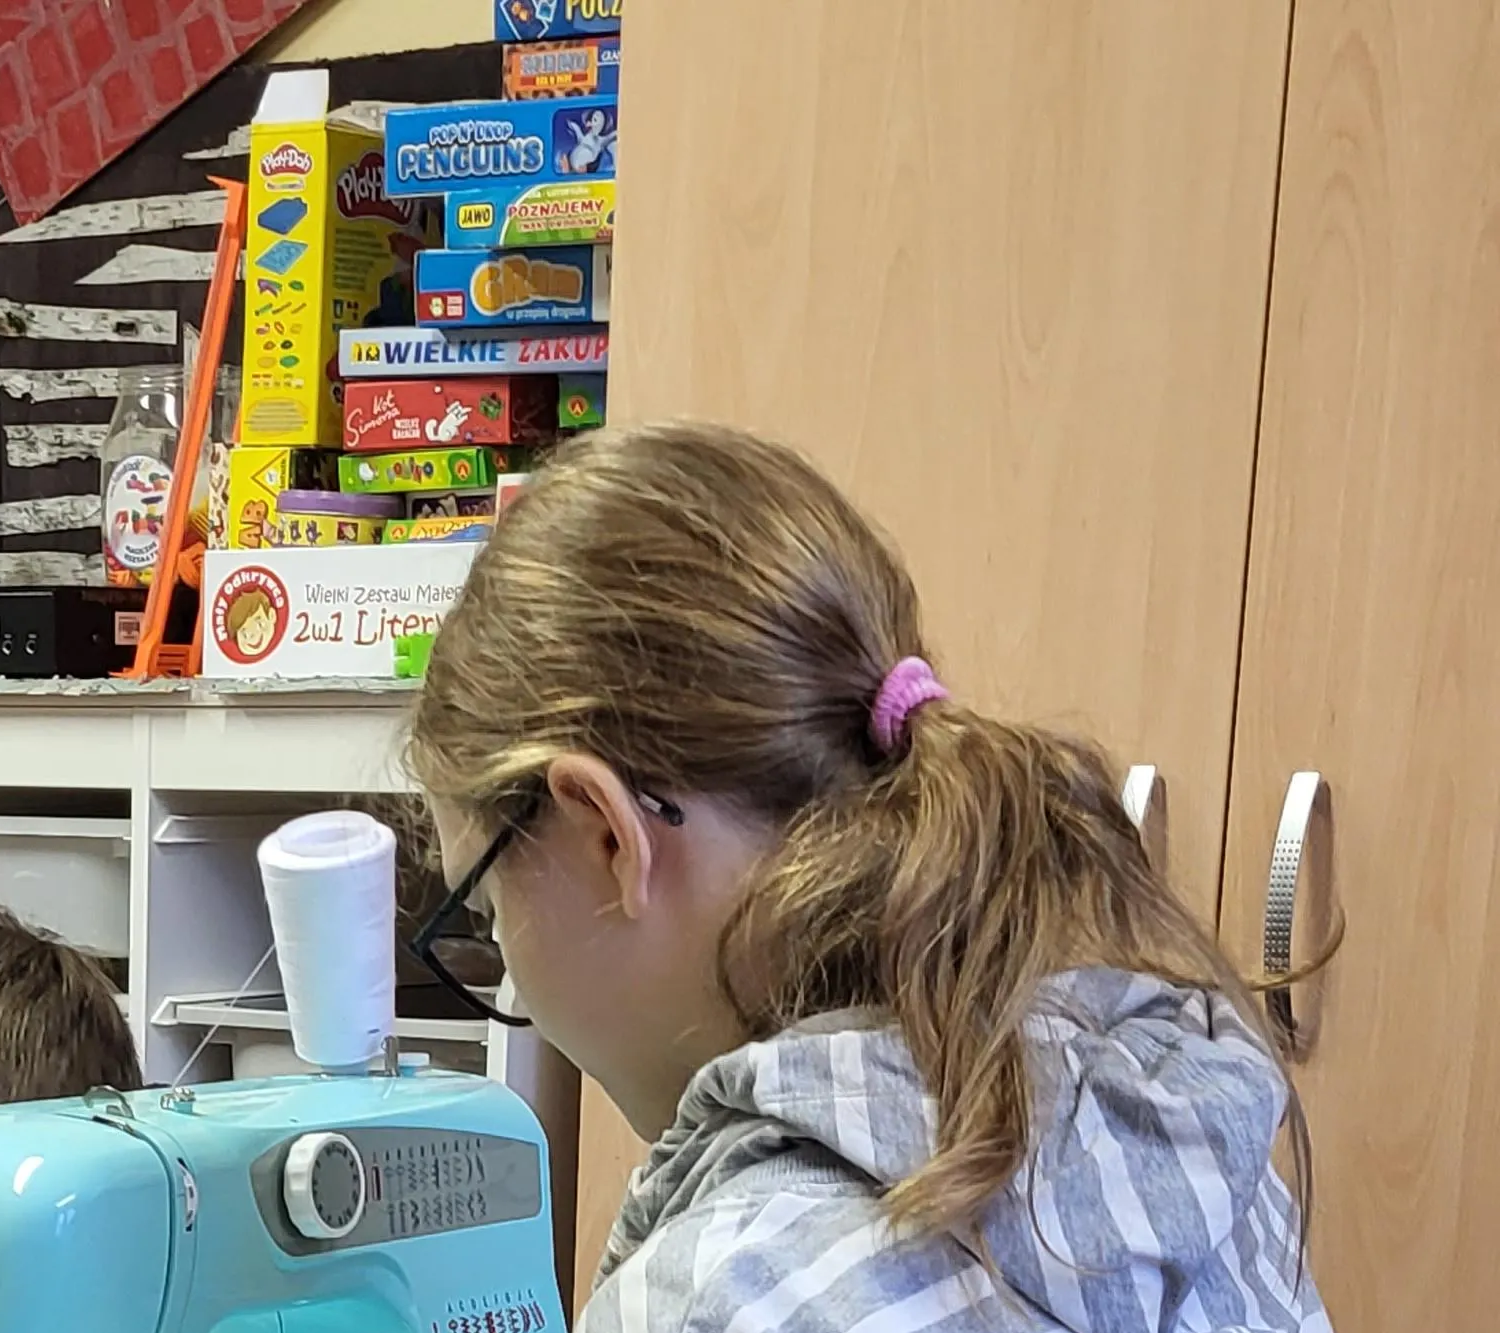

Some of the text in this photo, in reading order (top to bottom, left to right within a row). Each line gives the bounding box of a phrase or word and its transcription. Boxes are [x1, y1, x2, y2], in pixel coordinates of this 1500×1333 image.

[261, 148, 312, 174] Play-Doh
[398, 136, 544, 180] PENGUINS
[461, 207, 491, 225] JAWO
[508, 199, 605, 218] POZNAJEMY
[384, 339, 507, 364] WIELKIE
[305, 584, 349, 604] Wielki
[354, 586, 411, 605] Zestaw
[293, 611, 344, 643] 2w1
